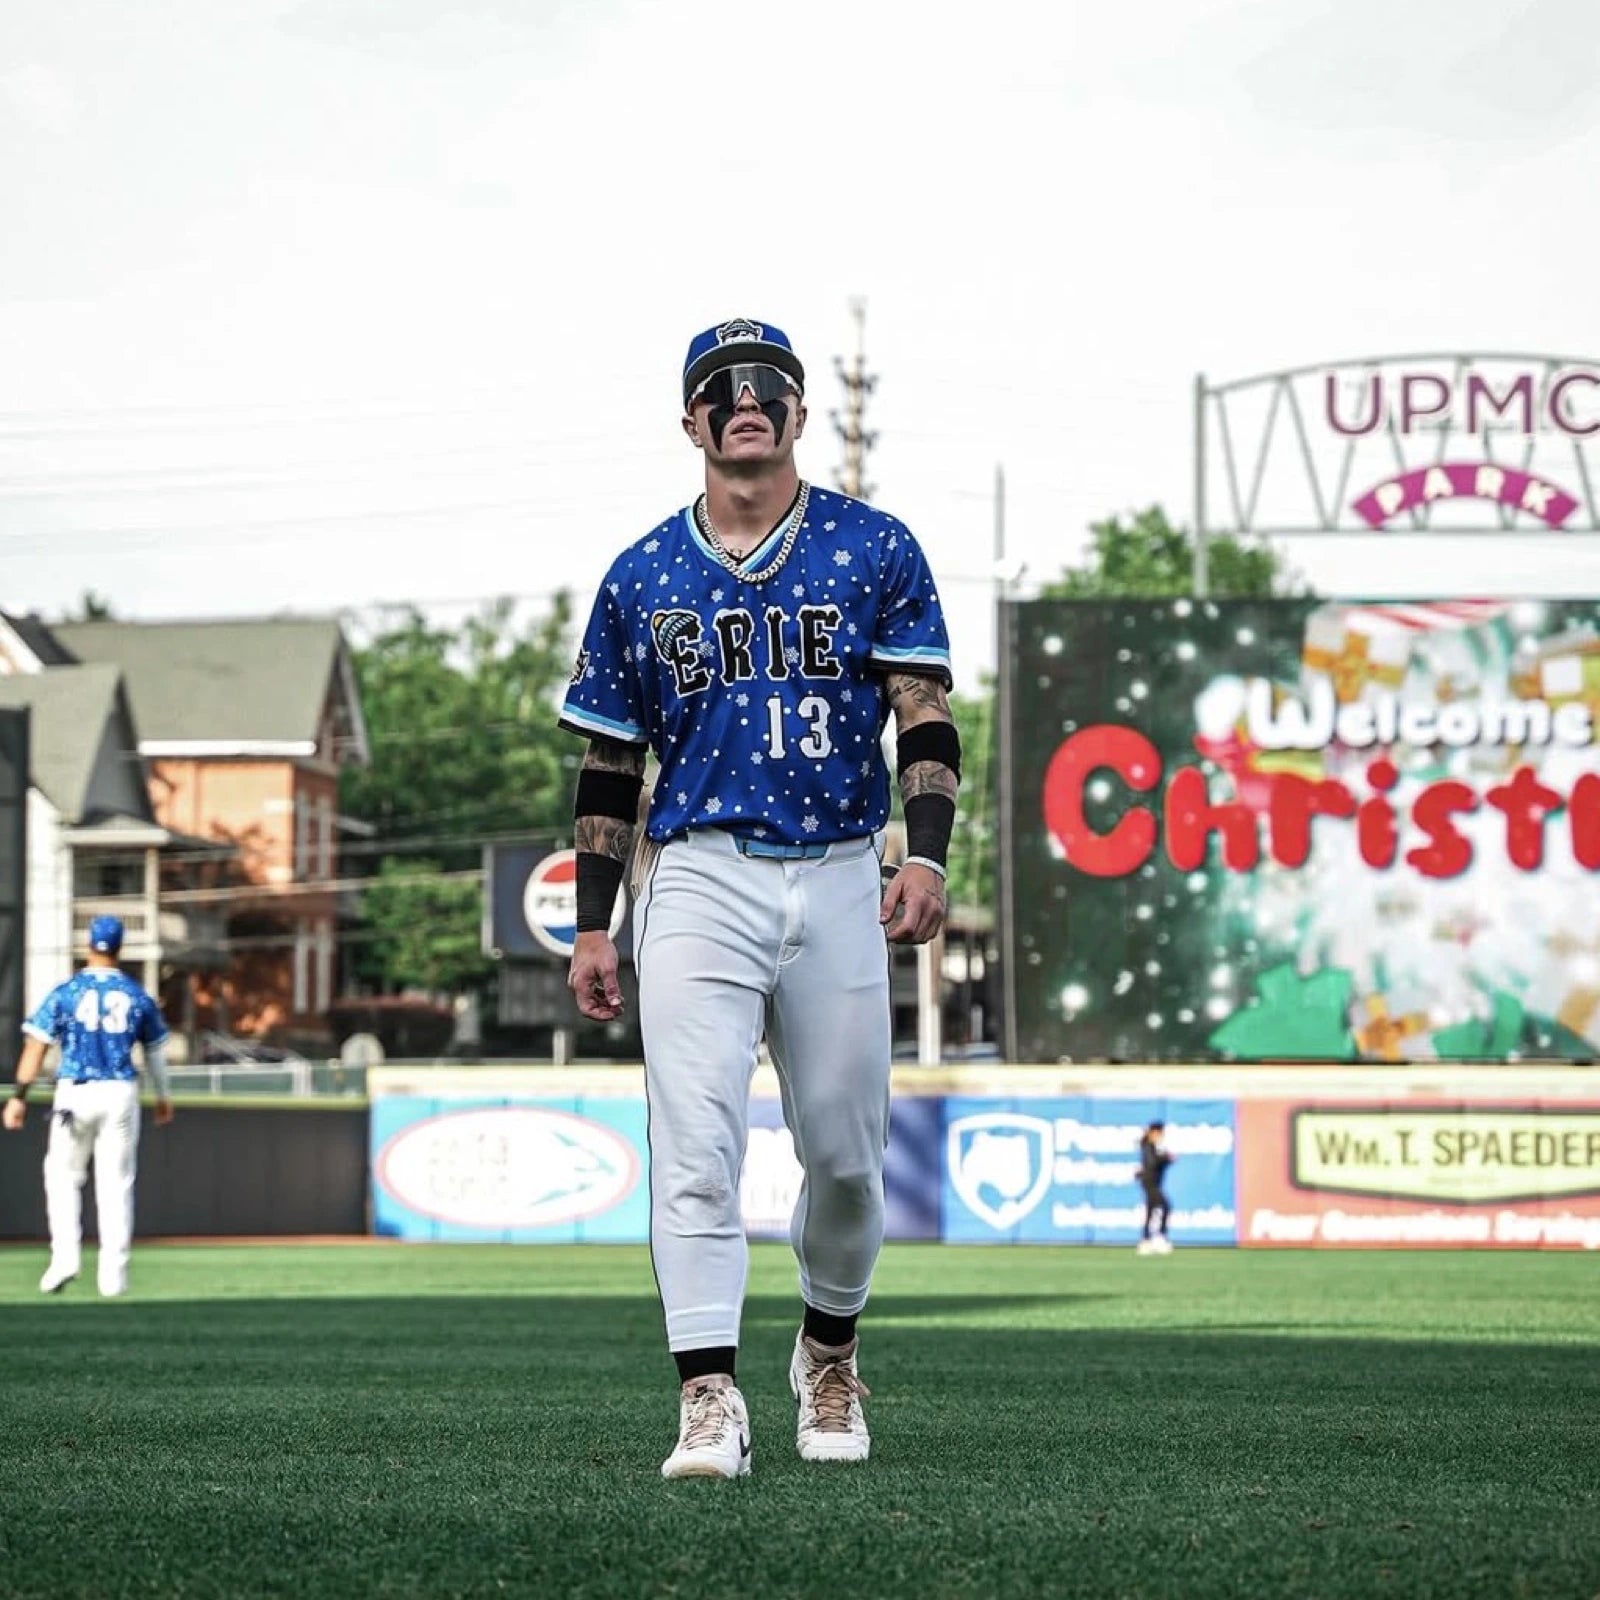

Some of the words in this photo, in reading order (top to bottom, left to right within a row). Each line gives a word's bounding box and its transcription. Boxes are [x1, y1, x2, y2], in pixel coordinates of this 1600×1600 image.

[1325, 373, 1600, 435] UPMC
[1375, 464, 1556, 518] PARK
[651, 604, 845, 698] ERIE
[766, 695, 833, 760] 13
[1246, 675, 1594, 749] Welcome
[75, 989, 132, 1034] 43
